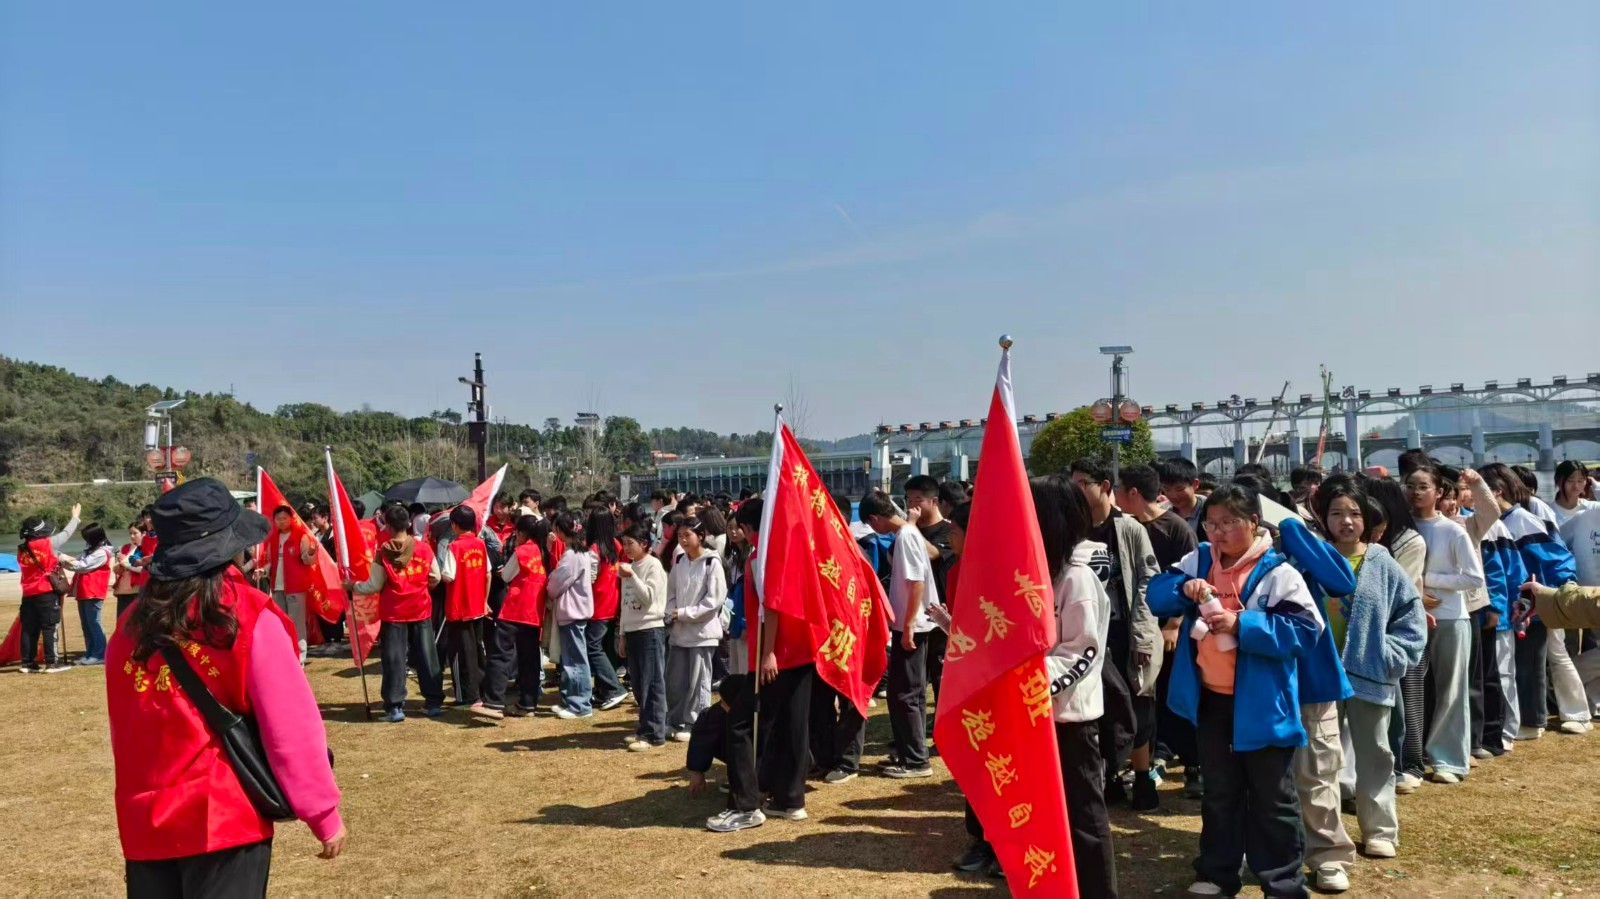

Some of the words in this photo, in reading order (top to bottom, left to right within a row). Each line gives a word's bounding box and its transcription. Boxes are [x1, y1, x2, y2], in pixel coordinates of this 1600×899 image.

[820, 618, 857, 672] 班
[1019, 667, 1052, 727] 班
[961, 708, 1057, 889] 超越自我
